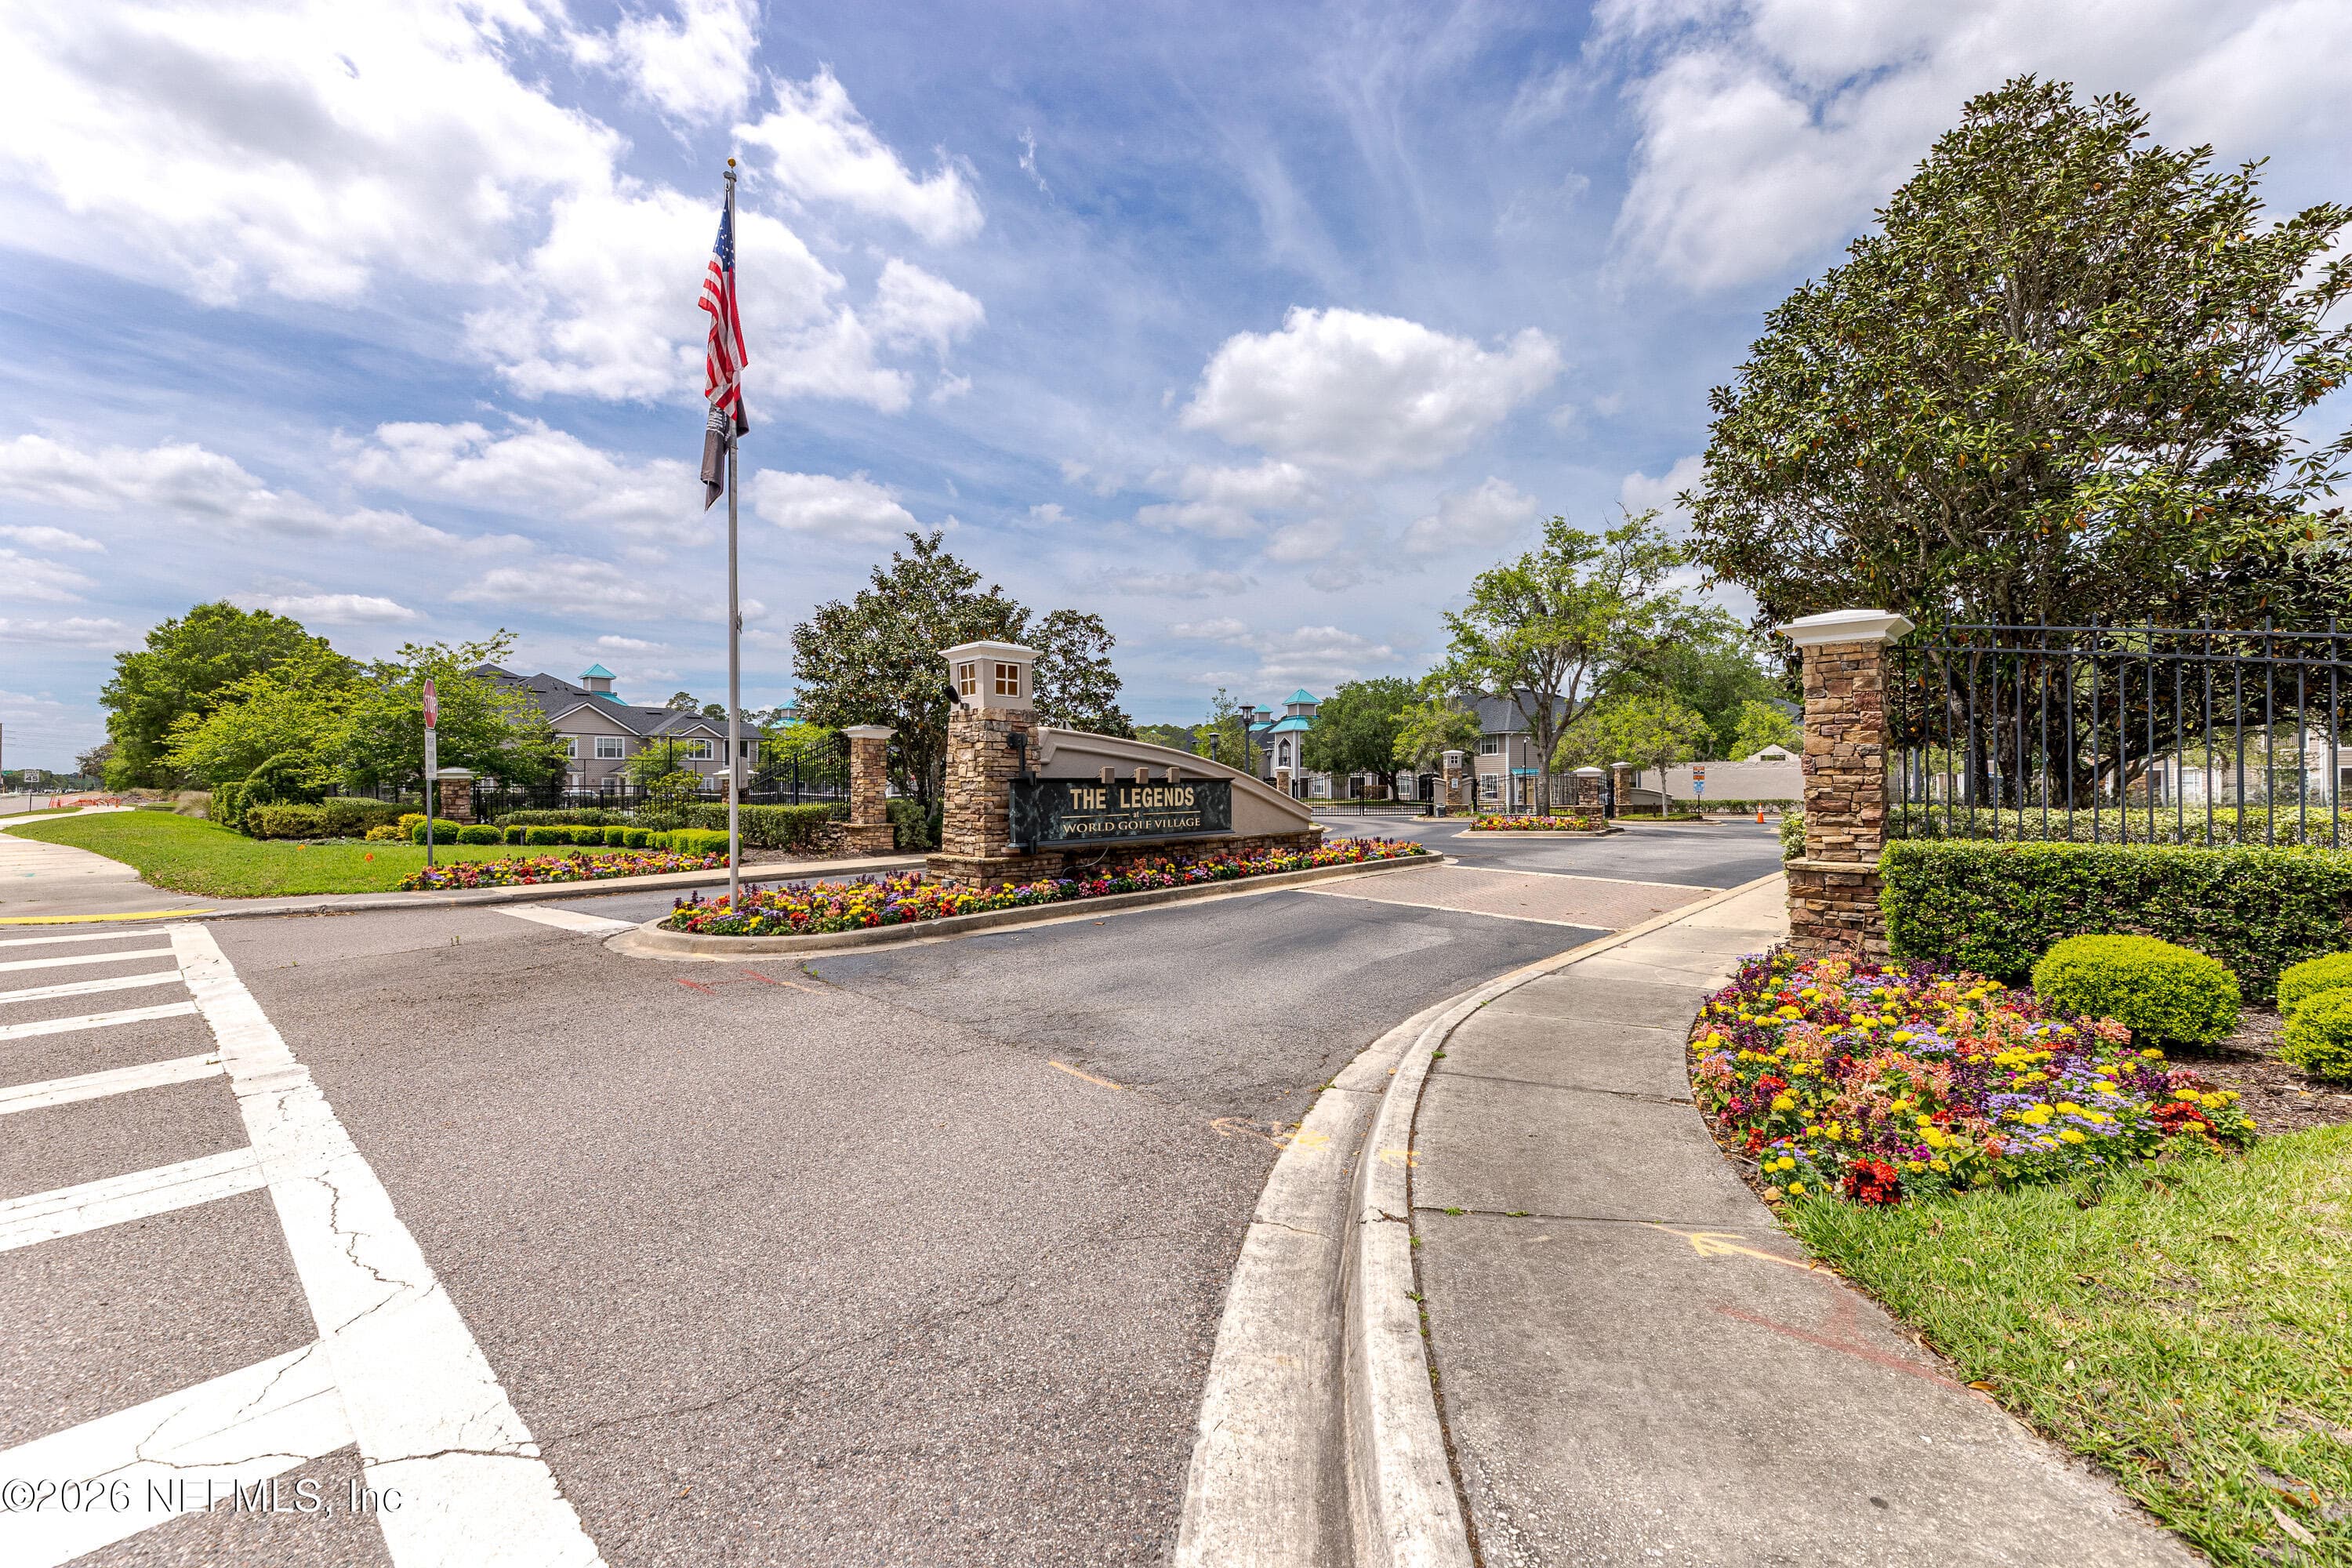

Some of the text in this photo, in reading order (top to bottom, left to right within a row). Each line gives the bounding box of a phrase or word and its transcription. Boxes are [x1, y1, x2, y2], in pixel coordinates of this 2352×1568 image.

[424, 695, 437, 713] STOP
[1069, 787, 1194, 809] THE LEGENDS
[1063, 818, 1201, 833] WORLD GOLF VILLAGE
